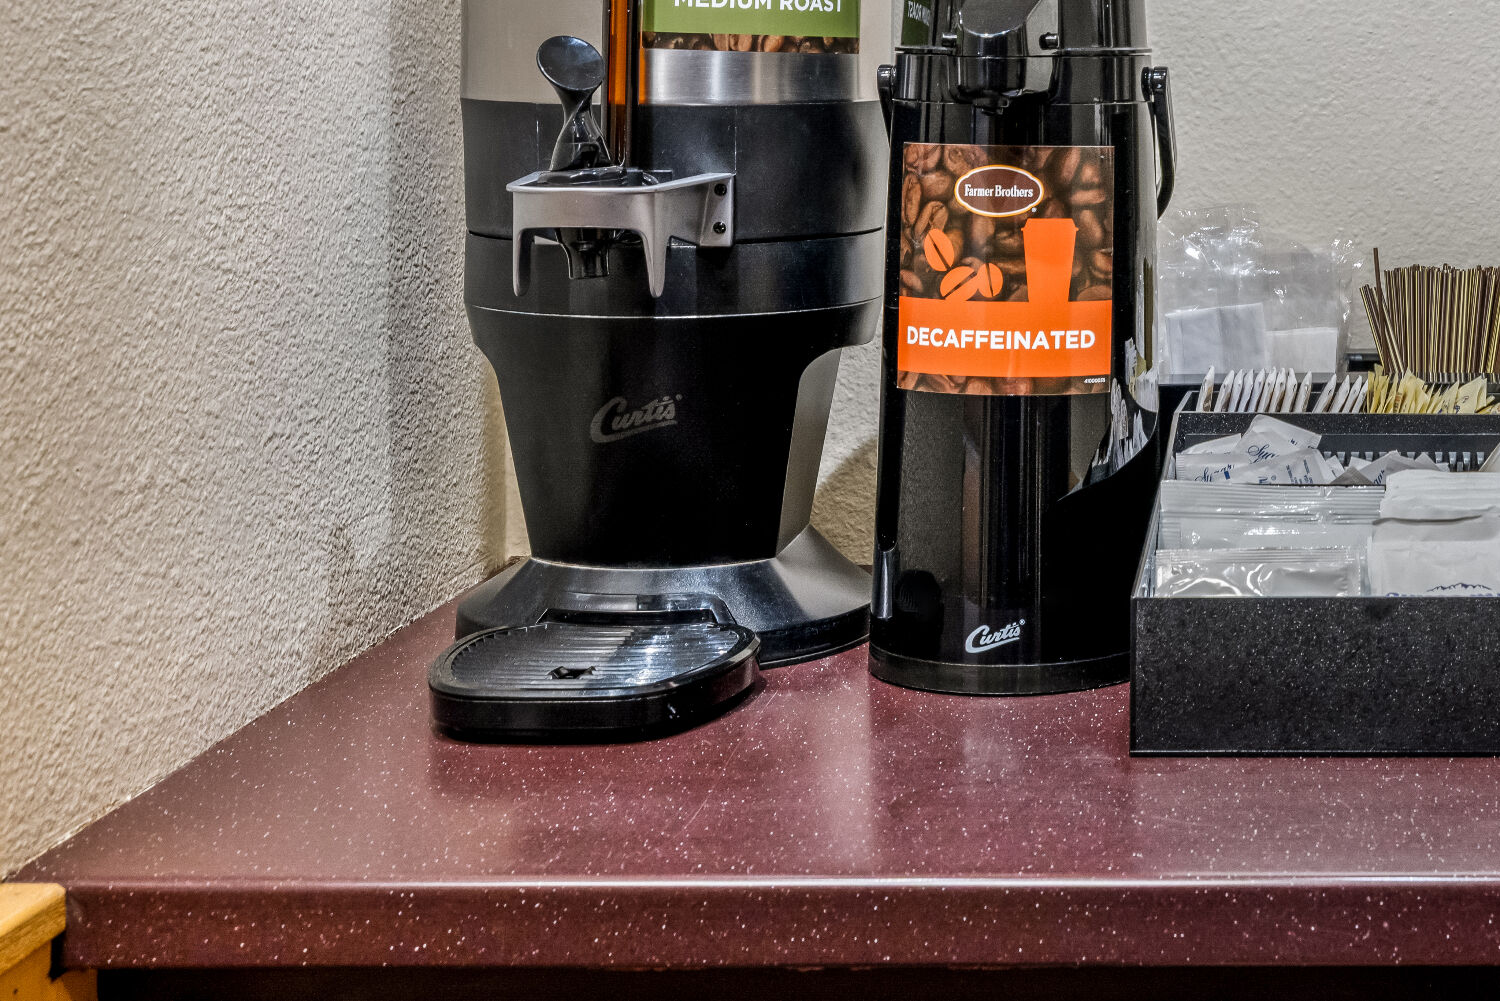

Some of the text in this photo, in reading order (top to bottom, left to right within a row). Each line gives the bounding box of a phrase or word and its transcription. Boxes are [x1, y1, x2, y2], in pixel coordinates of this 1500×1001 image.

[964, 183, 1034, 198] Farmer Brothers
[907, 325, 1096, 350] DECAFFEINATED
[589, 396, 679, 443] Curtis
[965, 622, 1021, 653] Curtis
